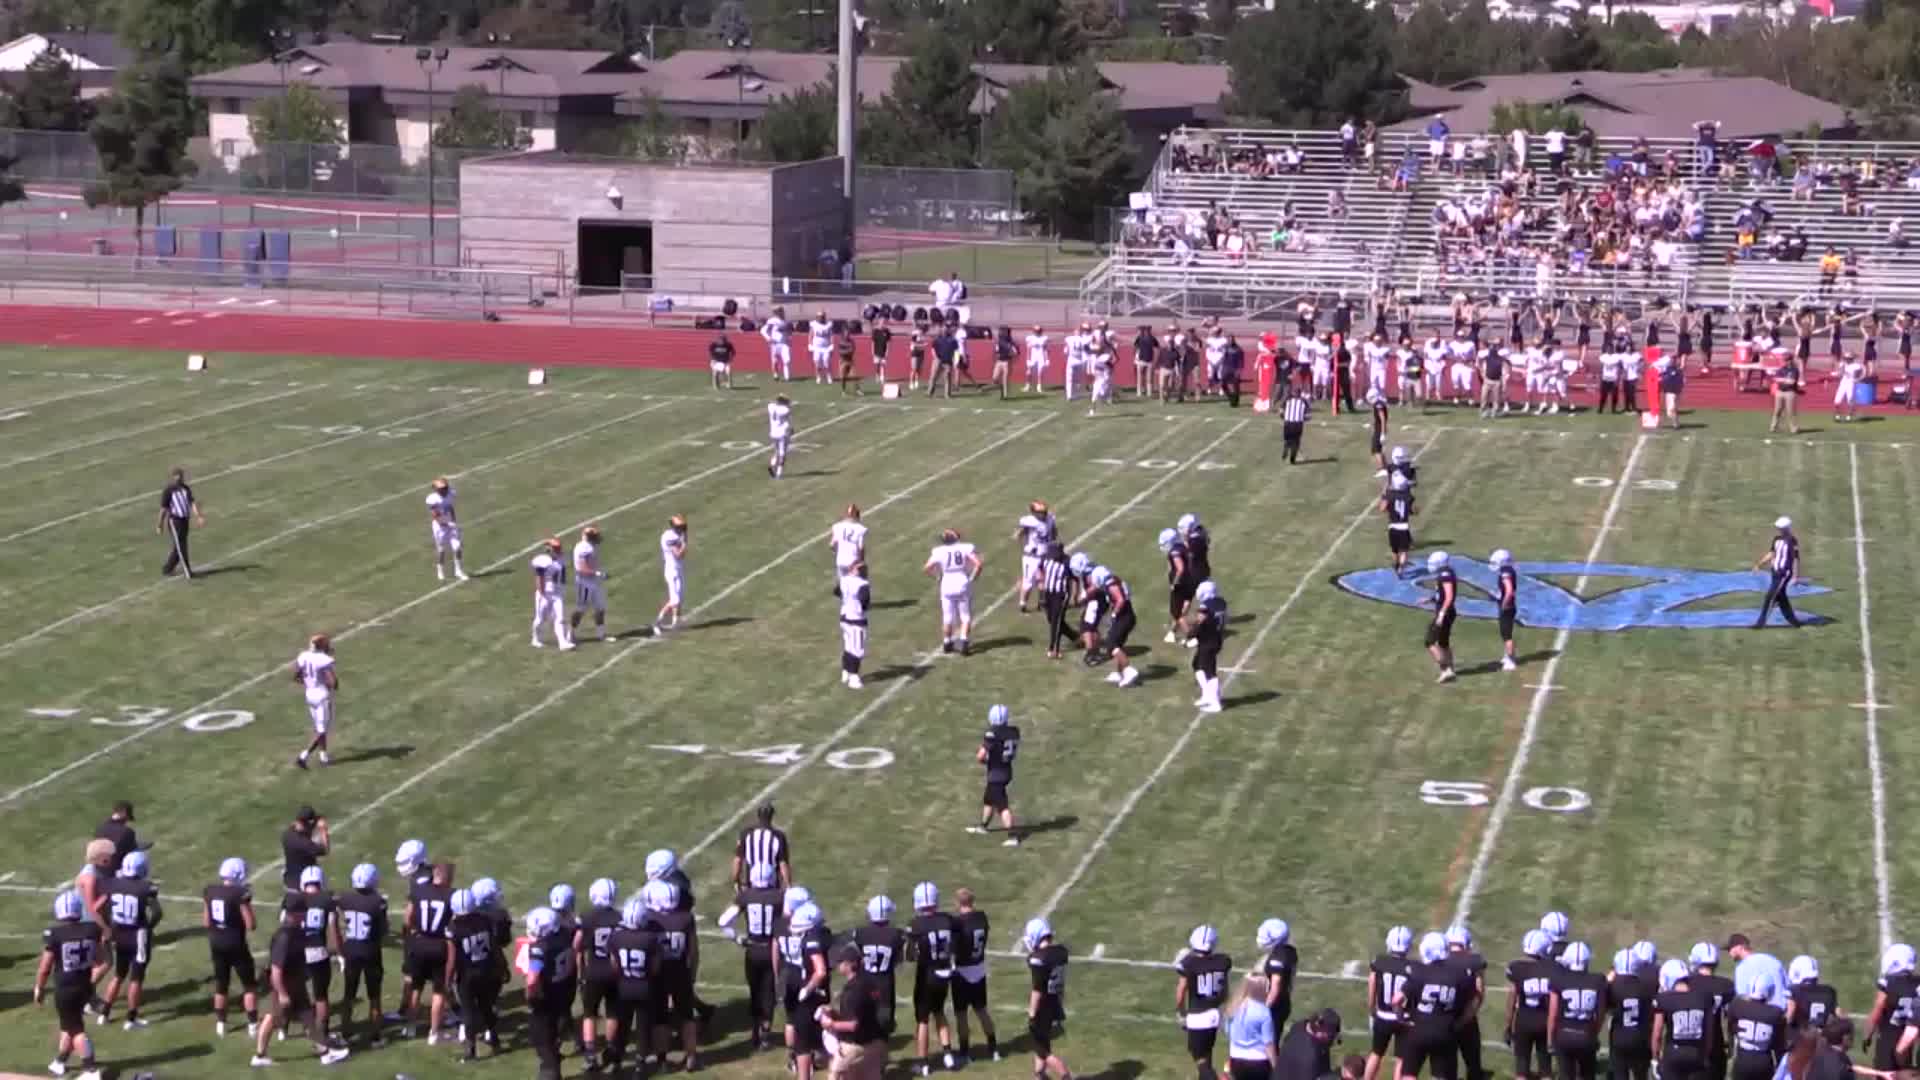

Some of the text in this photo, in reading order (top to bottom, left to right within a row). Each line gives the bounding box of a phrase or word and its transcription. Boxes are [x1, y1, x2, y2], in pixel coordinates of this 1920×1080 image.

[1419, 780, 1594, 812] 50
[111, 893, 139, 925] 20
[419, 899, 446, 932] 17
[863, 945, 893, 973] 27
[1622, 998, 1639, 1027] 2
